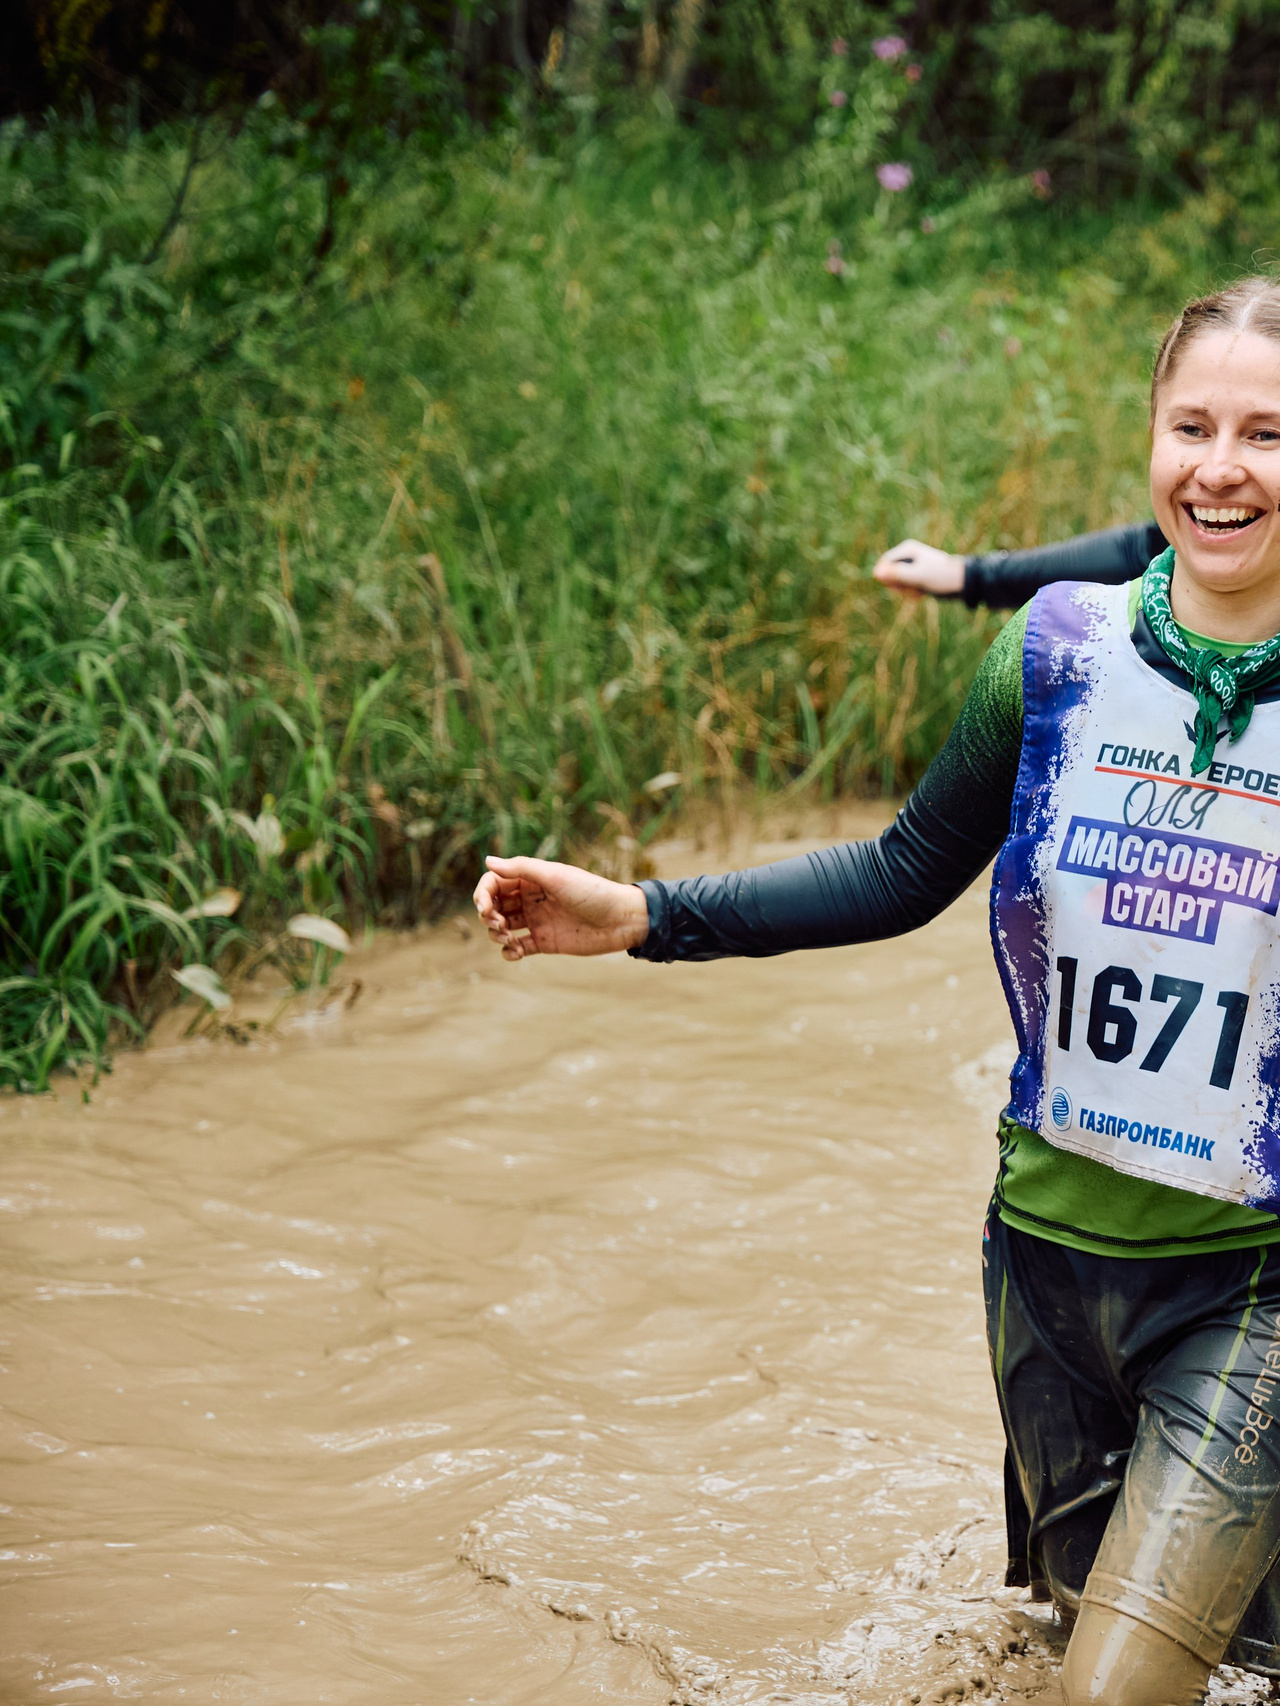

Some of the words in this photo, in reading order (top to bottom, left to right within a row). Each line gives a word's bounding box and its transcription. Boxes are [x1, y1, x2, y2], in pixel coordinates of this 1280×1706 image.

[1097, 743, 1181, 776] ГОНКА
[1110, 882, 1217, 938] СТАРТ
[1055, 956, 1250, 1091] 1671
[1079, 1107, 1216, 1162] ГАЗПРОМБАНК
